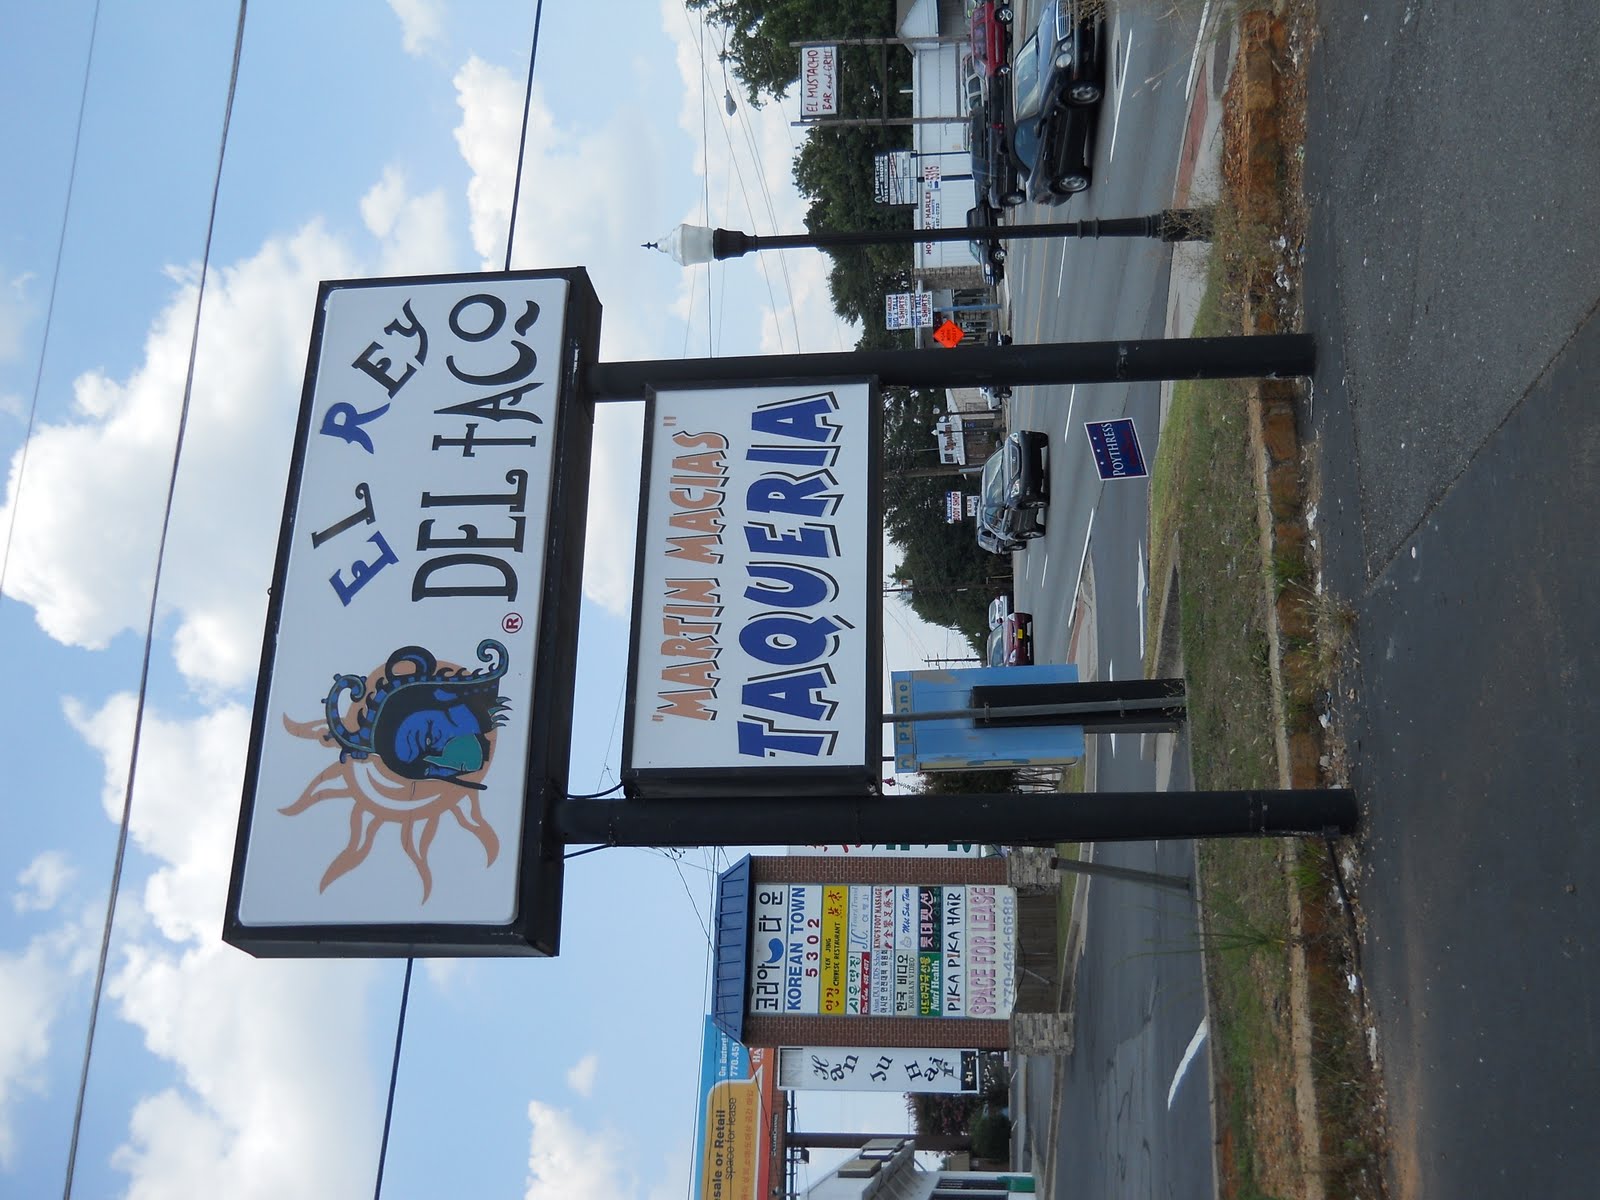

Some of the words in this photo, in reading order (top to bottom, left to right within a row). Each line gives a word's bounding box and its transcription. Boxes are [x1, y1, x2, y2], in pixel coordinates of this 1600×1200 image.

[806, 50, 819, 98] MUSTACHO
[806, 102, 818, 112] EL
[822, 93, 832, 110] BAR
[924, 166, 940, 180] 5315
[320, 298, 428, 454] REY
[432, 294, 544, 458] TACO
[1101, 423, 1126, 476] POYTHRESS
[952, 492, 960, 506] SHOP
[952, 508, 960, 520] BODY
[311, 482, 400, 607] EL
[412, 469, 528, 602] DEL
[736, 391, 855, 758] TAQUERIA
[790, 887, 806, 934] TOWN
[874, 888, 882, 914] MASSAGE
[970, 887, 996, 932] LEASE
[874, 915, 882, 929] FOOT
[833, 922, 841, 960] RESTAURANT
[946, 931, 961, 968] PIKA
[970, 936, 996, 964] FOR
[787, 942, 804, 1010] KOREAN
[832, 962, 840, 986] CHINESE
[896, 954, 908, 984] 비디오
[931, 960, 940, 989] Health
[756, 964, 780, 1010] 코리아
[896, 992, 908, 1012] 한국
[946, 974, 961, 1011] PIKA
[970, 968, 996, 1014] SPACE
[726, 1097, 736, 1126] lease
[714, 1110, 726, 1148] Retail
[724, 1130, 734, 1143] for
[715, 1152, 724, 1166] or
[724, 1146, 736, 1180] space
[712, 1171, 722, 1200] sale
